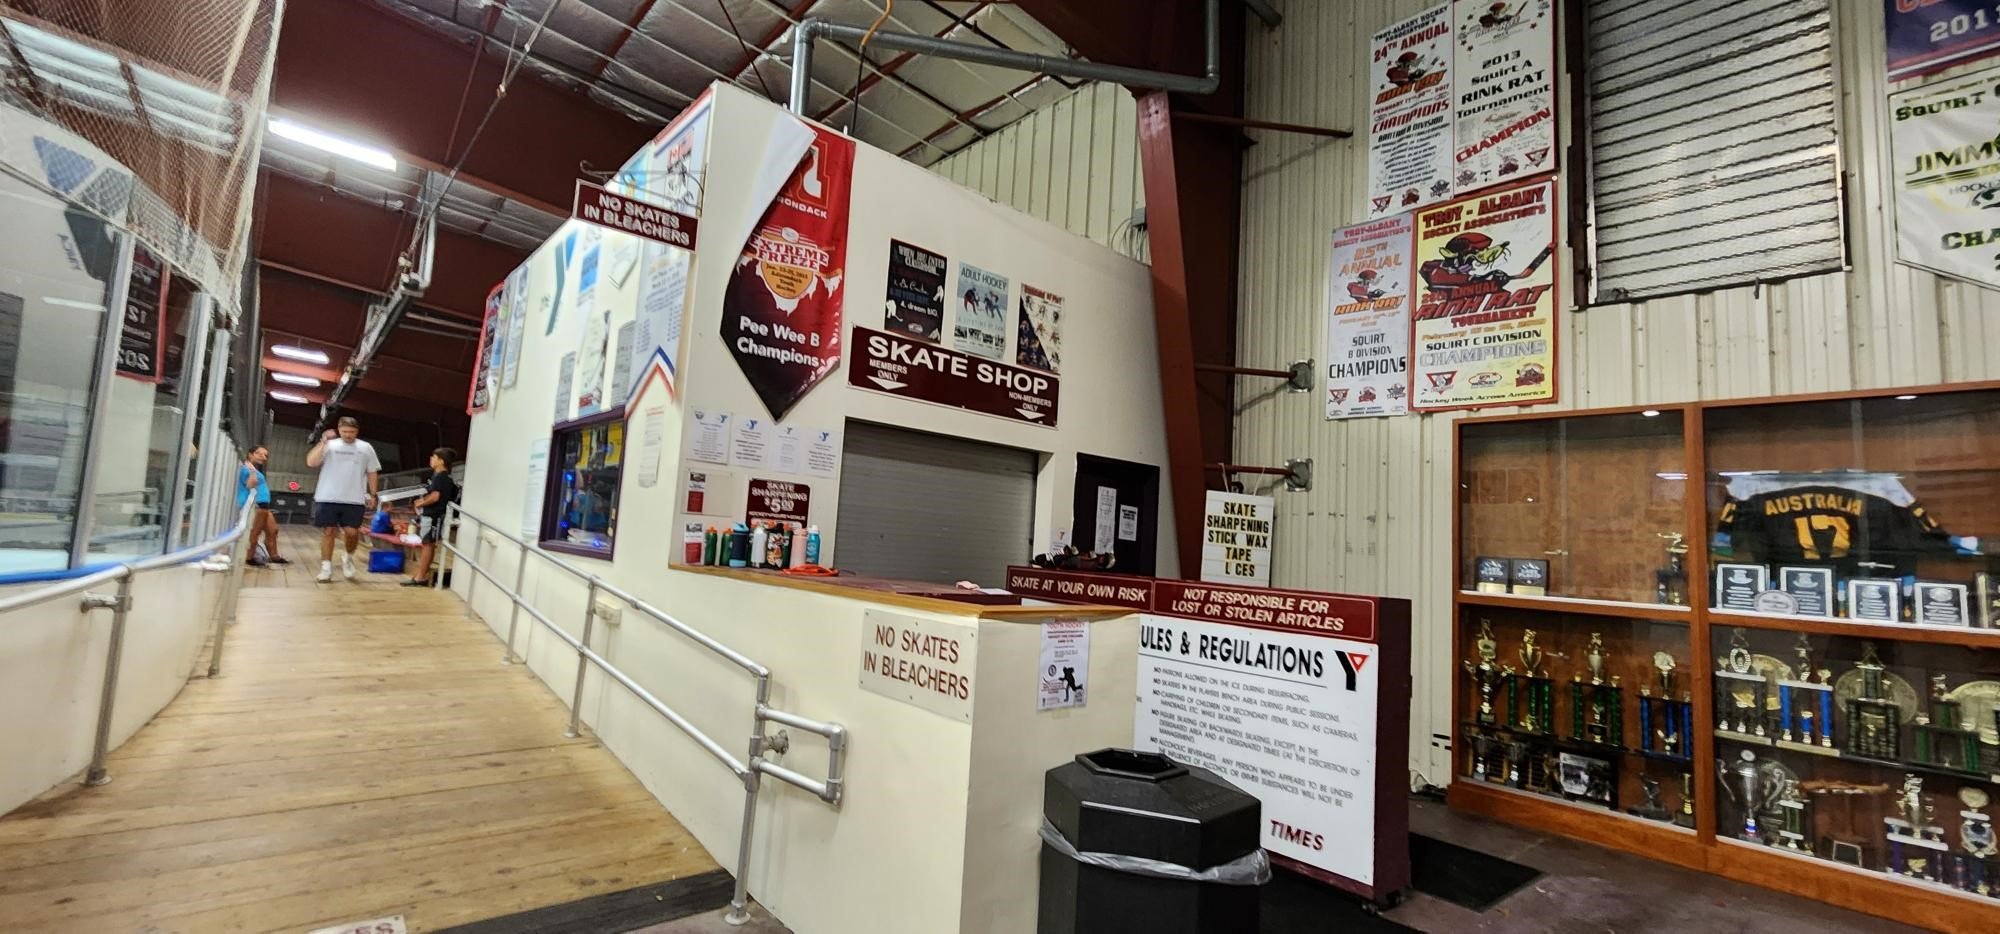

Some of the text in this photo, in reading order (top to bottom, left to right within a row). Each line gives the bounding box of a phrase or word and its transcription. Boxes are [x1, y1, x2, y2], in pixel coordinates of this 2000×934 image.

[1401, 21, 1449, 51] ANNUAL
[1471, 59, 1533, 86] Squirt A
[1482, 50, 1521, 70] 2013
[1461, 69, 1546, 105] RINK RAT
[1455, 84, 1551, 119] Tournament
[1895, 90, 1986, 122] SQUIRT
[1372, 100, 1449, 134] CHAMPIONS
[1455, 106, 1551, 163] CHAMPION
[599, 193, 680, 229] NO SKATES
[1422, 185, 1547, 229] TROY ALBANY
[584, 204, 690, 246] IN BLEACHERS
[750, 235, 828, 265] EXTREME
[758, 250, 818, 270] FREEZE
[961, 267, 1007, 290] ADULT HOCKEY
[1414, 294, 1484, 321] RINK
[1483, 285, 1552, 311] RAT
[740, 316, 820, 347] Pee Wee B
[1451, 306, 1536, 329] TOURNAMENT
[737, 337, 820, 368] Champions
[1352, 333, 1386, 347] SQUIRT
[1356, 346, 1392, 358] DIVISION
[1420, 340, 1548, 368] CHAMPIONS
[1426, 338, 1470, 351] SQUIRT
[1473, 337, 1481, 346] C
[1484, 329, 1542, 344] DIVISION
[868, 335, 1049, 395] SKATE SHOP
[869, 358, 908, 375] MEMBERS
[877, 370, 899, 382] ONLY
[1329, 356, 1406, 379] CHAMPIONS
[1009, 391, 1052, 408] NON-MEMBERS
[1022, 402, 1039, 412] ONLY
[752, 487, 808, 502] SHARPENING
[767, 481, 795, 492] SKATE
[1224, 502, 1257, 518] SKATE
[1764, 492, 1863, 517] AUSTRALIA
[1207, 515, 1269, 534] SHARPENING
[1795, 515, 1851, 560] 17
[1208, 530, 1268, 548] STICK WAX
[1226, 547, 1252, 562] TAPE
[1011, 576, 1148, 603] SKATE AT YOUR OWN RISK
[1184, 588, 1330, 615] NOT RESPONSIBLE FOR
[1172, 600, 1345, 632] LOST OR STOLEN ARTICLES
[876, 624, 960, 664] NO SKATES
[1180, 631, 1191, 656] &
[1200, 634, 1324, 679] REGULATIONS
[864, 650, 969, 701] IN BLEACHERS
[1185, 673, 1207, 683] ALLOWED
[1232, 682, 1240, 690] ICE
[1243, 684, 1265, 694] DURING
[1161, 691, 1186, 701] CARRYING
[1196, 700, 1221, 711] CHILDREN
[1233, 707, 1268, 721] SECONDARY
[1292, 720, 1309, 729] SUCH
[1312, 724, 1321, 733] AS
[1201, 710, 1216, 719] WHILE
[1222, 692, 1240, 701] BENCH
[1243, 697, 1258, 705] AREA
[1261, 700, 1284, 711] DURING
[1286, 705, 1307, 716] PUBLIC
[1177, 716, 1198, 726] SKATING
[1274, 739, 1296, 750] EXCEPT
[1299, 745, 1306, 753] IN
[1308, 747, 1319, 757] THE
[1189, 727, 1203, 737] AREA
[1205, 731, 1217, 741] AND
[1227, 737, 1262, 752] DESIGNATED
[1264, 746, 1280, 758] TIMES
[1295, 752, 1306, 764] THE
[1309, 757, 1348, 774] DISCRETION
[1351, 768, 1361, 777] OF
[1193, 757, 1201, 765] OF
[1203, 761, 1228, 775] ALCOHOL
[1230, 768, 1240, 777] OR
[1262, 778, 1299, 795] SUBSTANCES
[1301, 790, 1316, 800] WILL
[1318, 794, 1332, 805] NOT
[1335, 799, 1343, 808] BE
[1222, 757, 1233, 765] ANY
[1236, 761, 1258, 773] PERSON
[1260, 768, 1276, 778] WHO
[1279, 773, 1306, 787] APPEARS
[1308, 780, 1317, 790] TO
[1320, 784, 1328, 793] BE
[1330, 787, 1354, 800] UNDER
[1271, 819, 1325, 851] TIMES
